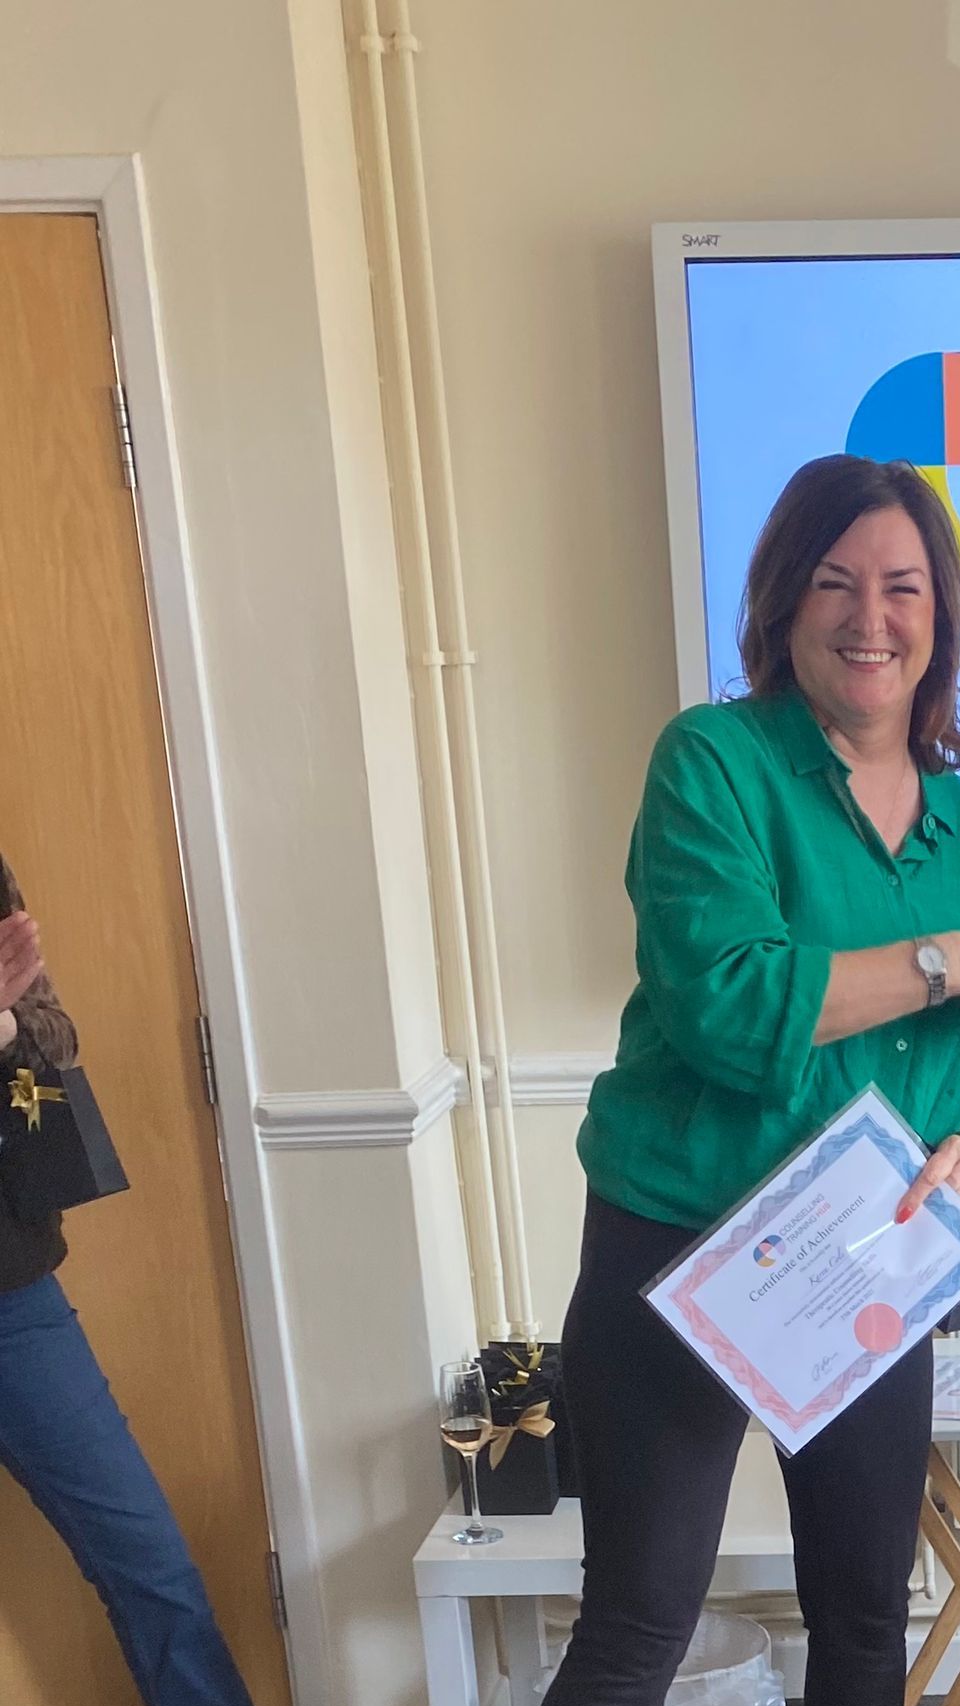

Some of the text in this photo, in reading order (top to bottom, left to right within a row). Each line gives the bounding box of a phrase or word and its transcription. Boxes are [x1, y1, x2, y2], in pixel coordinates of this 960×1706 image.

[681, 233, 721, 247] SMART
[778, 1192, 825, 1237] COUNSELLING
[785, 1201, 832, 1244] TRAINING HUB
[747, 1256, 798, 1304] Certificate
[793, 1244, 810, 1261] of
[804, 1193, 866, 1251] Achievement
